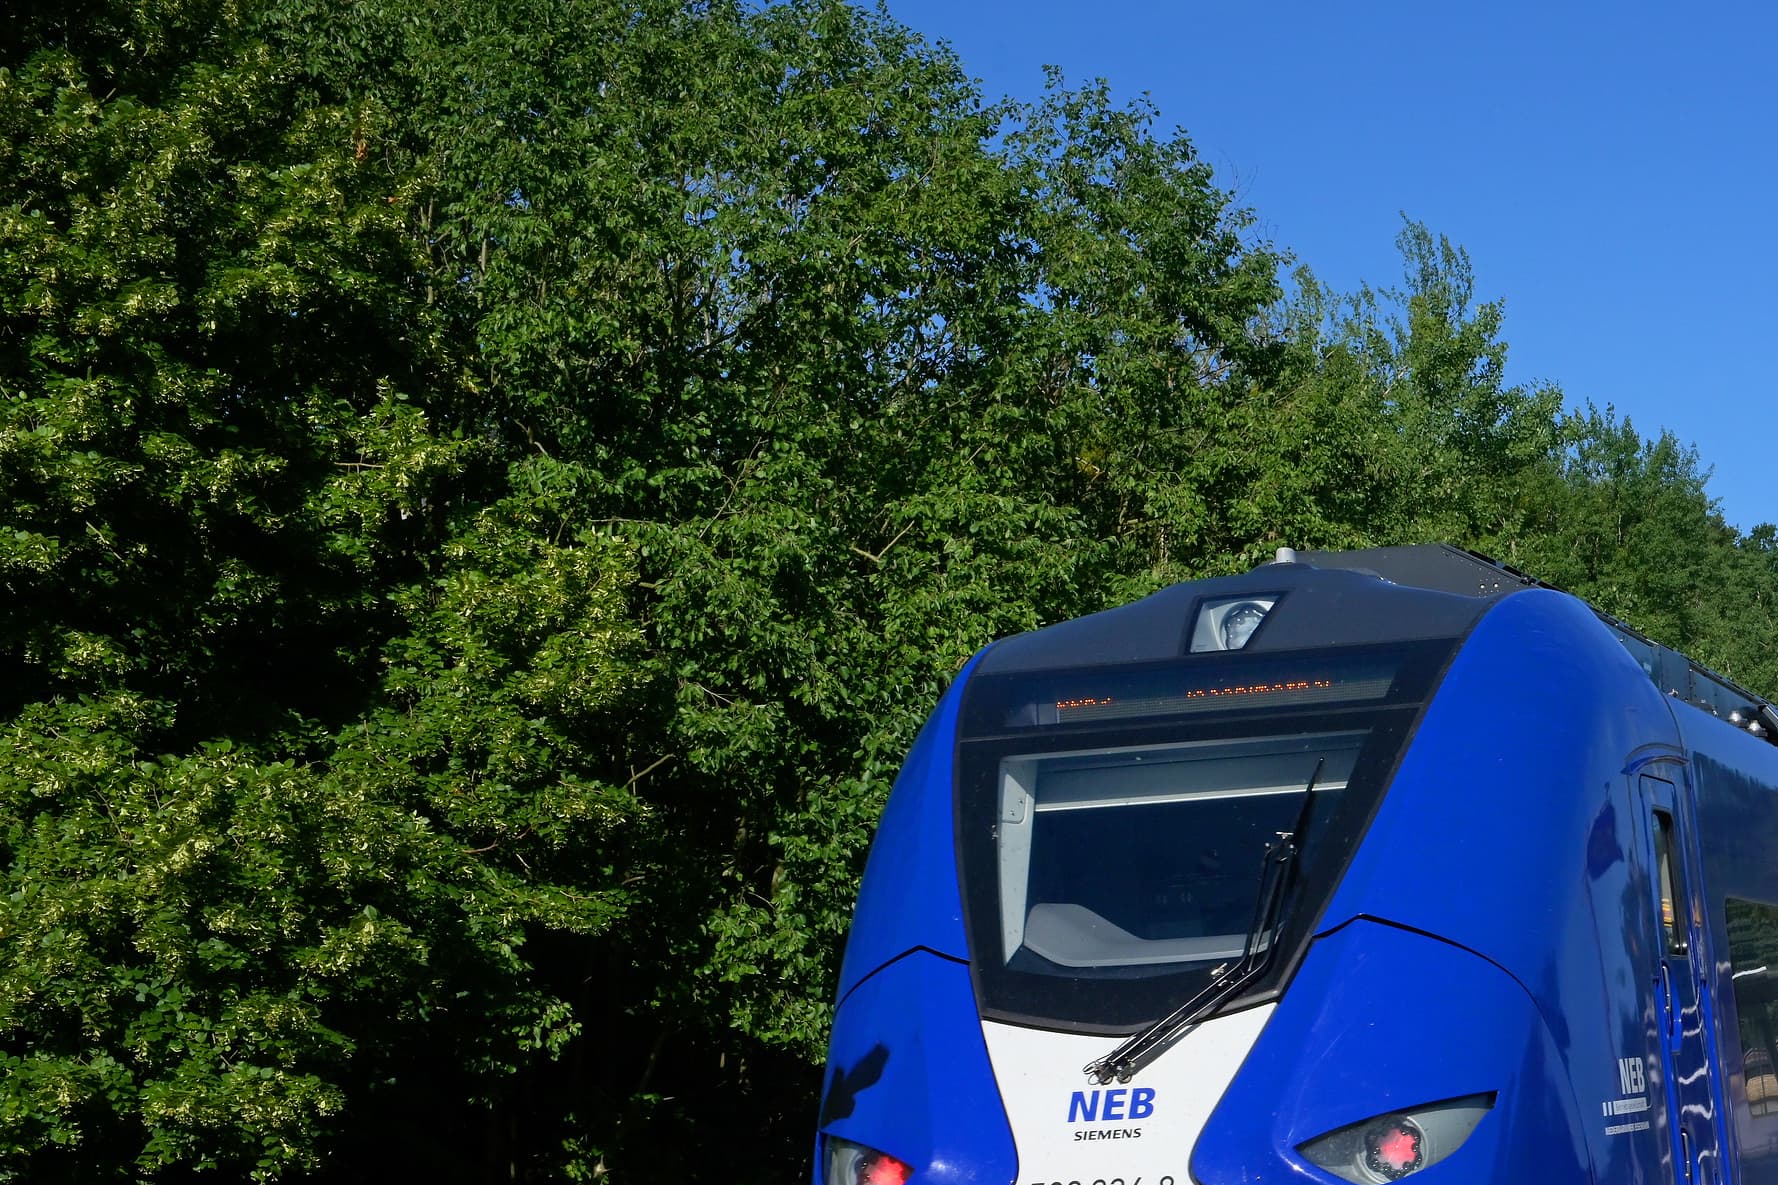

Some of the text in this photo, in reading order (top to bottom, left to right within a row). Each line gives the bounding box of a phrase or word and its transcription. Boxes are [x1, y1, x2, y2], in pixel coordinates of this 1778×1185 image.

[1619, 1057, 1646, 1095] NEB
[1067, 1087, 1156, 1123] NEB
[1073, 1128, 1142, 1142] SIEMENS
